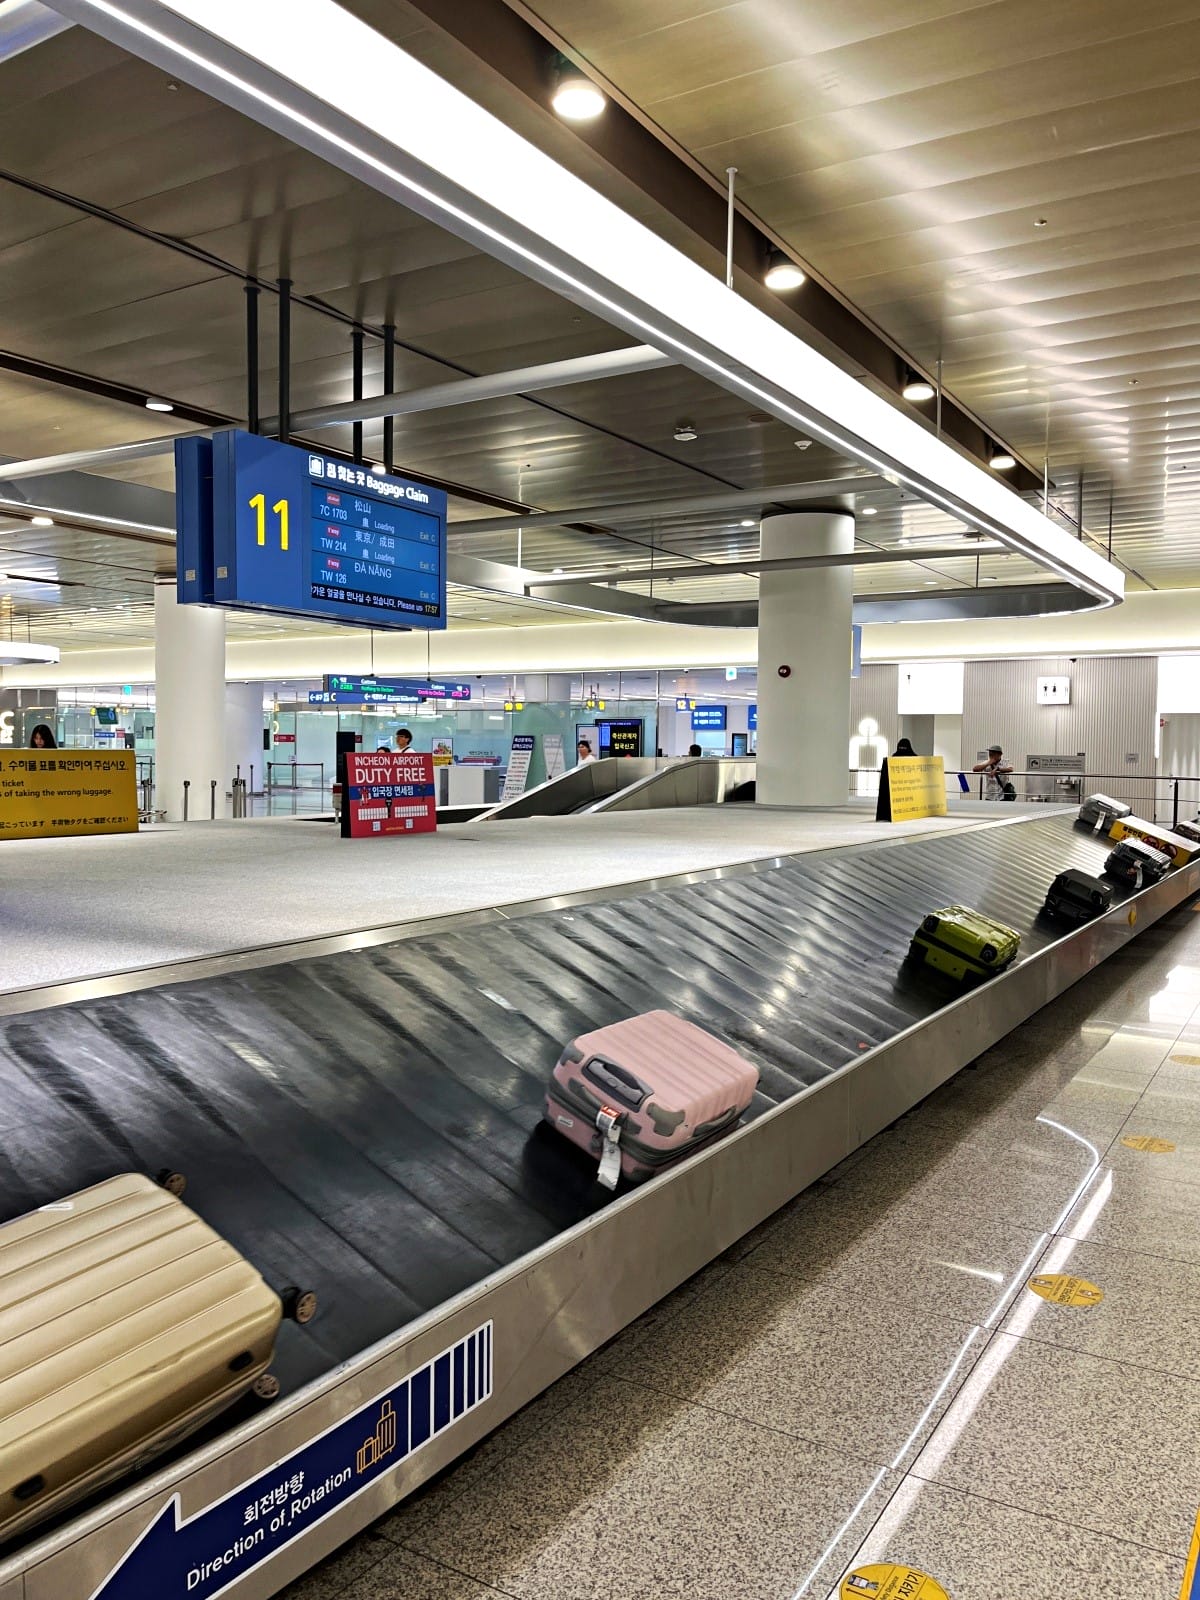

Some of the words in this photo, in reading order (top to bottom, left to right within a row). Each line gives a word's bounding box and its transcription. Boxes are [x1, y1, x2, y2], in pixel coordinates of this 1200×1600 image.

[366, 476, 404, 498] Baggage
[406, 487, 429, 504] Claim
[320, 505, 330, 516] 7C
[332, 508, 347, 520] 1703
[249, 494, 288, 550] 11
[375, 520, 394, 534] Loading
[320, 537, 333, 549] TW
[335, 540, 347, 552] 214
[375, 551, 394, 564] Loading
[320, 569, 333, 582] TW
[335, 573, 347, 584] 126
[327, 588, 345, 600] 얼굴을
[346, 591, 364, 602] 만나실
[365, 594, 371, 604] 수
[397, 601, 415, 611] Please
[354, 756, 390, 766] INCHEON
[393, 756, 424, 766] AIRPORT
[2, 779, 24, 787] ticket
[355, 768, 392, 784] DUTY
[396, 767, 427, 783] FREE
[4, 789, 13, 797] of
[15, 789, 40, 798] taking
[42, 788, 55, 796] the
[57, 789, 81, 798] wrong
[372, 786, 392, 797] 입국장
[394, 785, 413, 797] 면세점
[244, 1471, 304, 1525] 회전방향
[187, 1528, 264, 1591] Direction
[270, 1510, 285, 1532] of
[291, 1467, 351, 1519] Rotation
